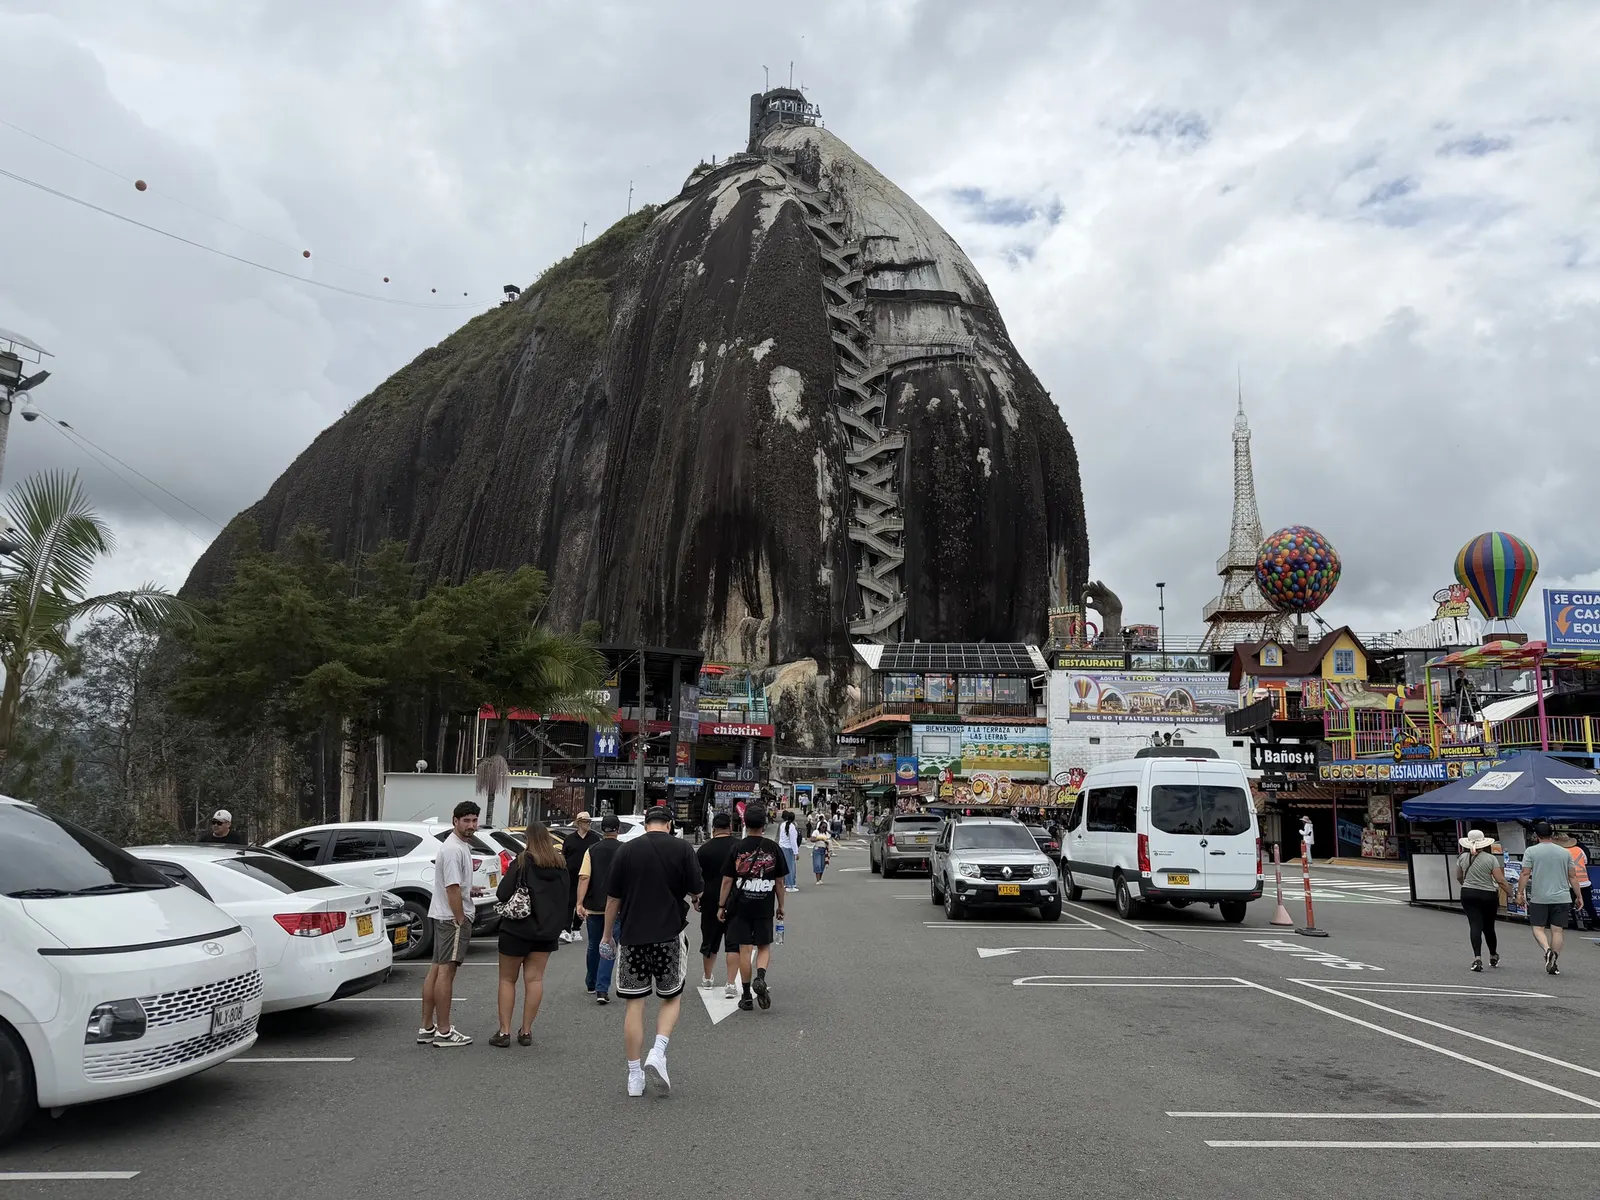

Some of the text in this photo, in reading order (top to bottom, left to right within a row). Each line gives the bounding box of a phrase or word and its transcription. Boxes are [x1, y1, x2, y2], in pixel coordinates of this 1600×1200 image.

[1554, 594, 1570, 605] SE
[1445, 616, 1483, 646] BAR
[1058, 659, 1125, 668] RESTAURANTE
[925, 725, 965, 733] BIENVENIDOS
[840, 736, 860, 744] Baños
[1440, 746, 1481, 755] MICHELADAS
[1264, 749, 1303, 764] Baños
[1390, 763, 1444, 779] RESTAURANTE
[1261, 781, 1281, 789] Baños
